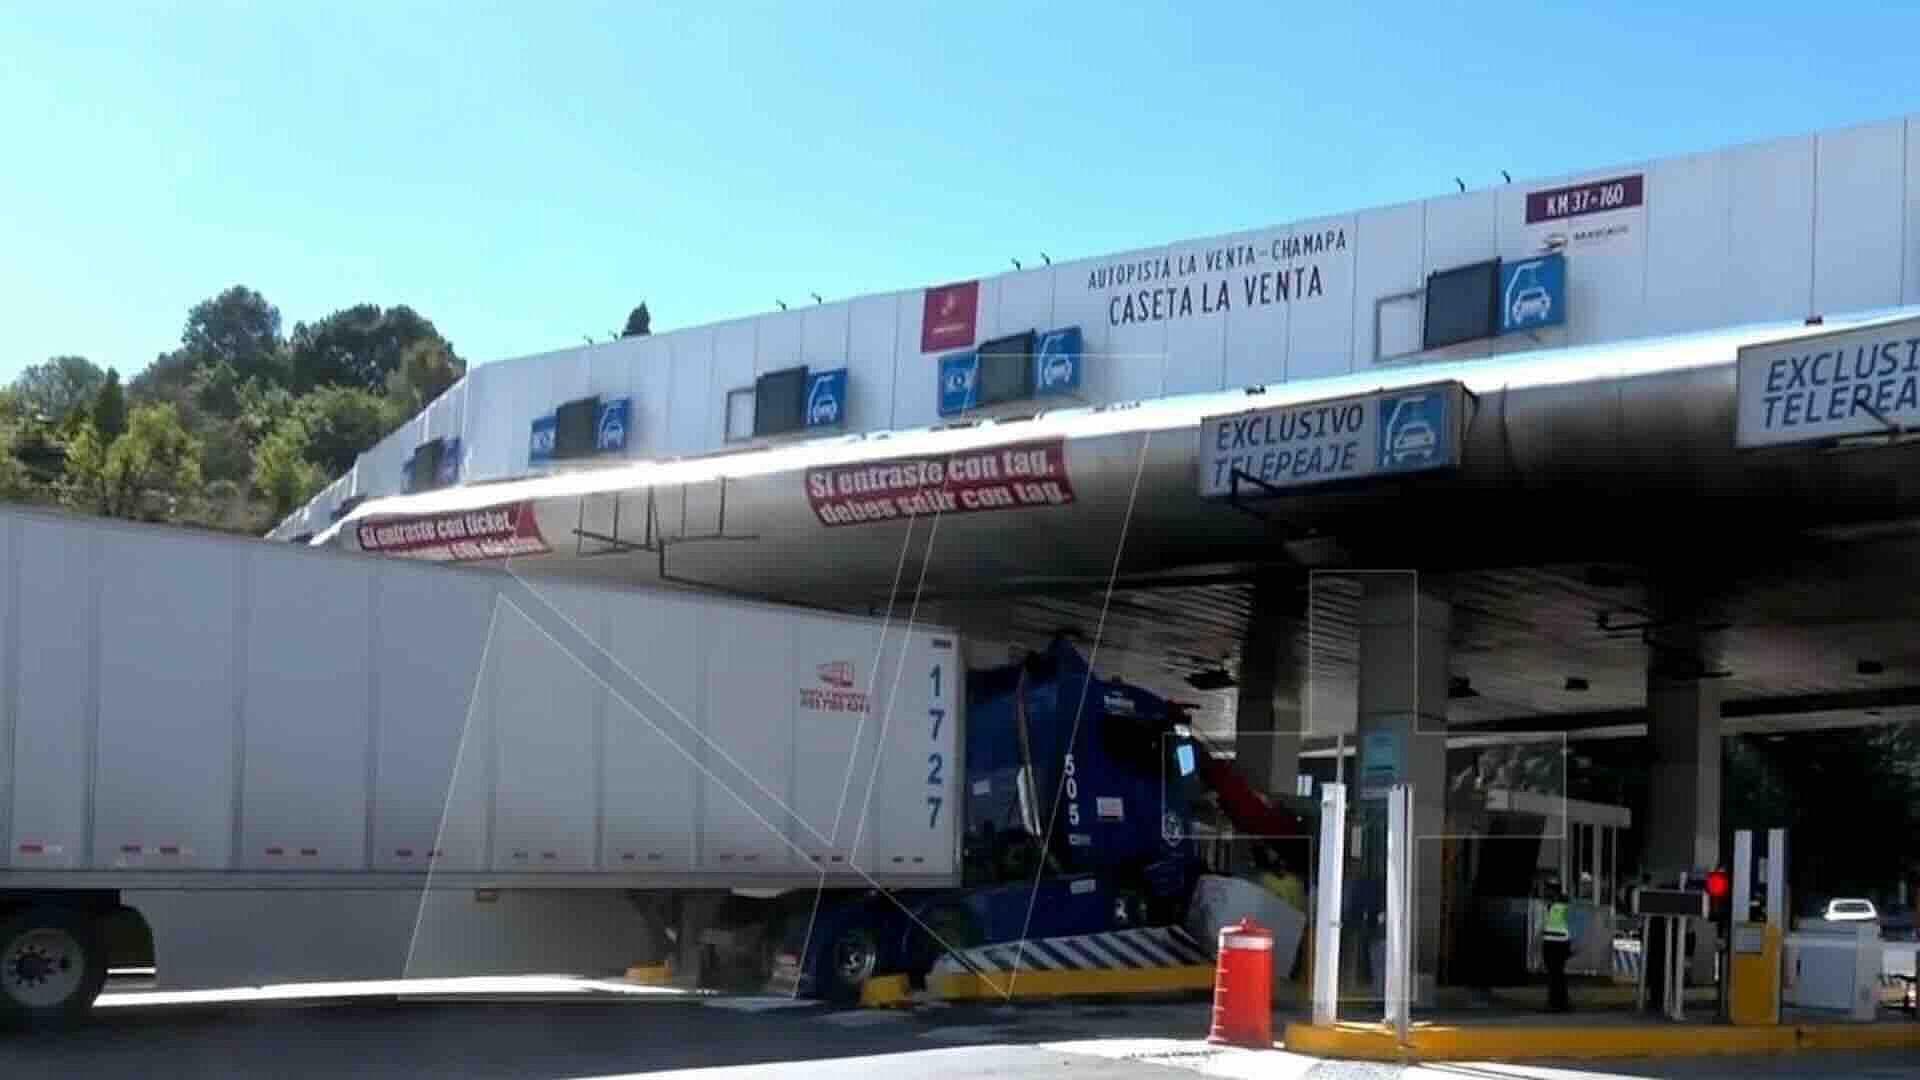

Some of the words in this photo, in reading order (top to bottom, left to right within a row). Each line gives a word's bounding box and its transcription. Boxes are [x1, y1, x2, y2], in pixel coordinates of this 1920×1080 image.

[1546, 193, 1569, 217] KM
[1087, 258, 1171, 291] AUTOPISTA
[1179, 255, 1197, 278] LA
[1109, 284, 1193, 327] CASETA
[1203, 279, 1232, 314] LA
[1244, 265, 1324, 307] VENTA
[1216, 403, 1364, 451] EXCLUSIVO
[948, 453, 998, 481] con
[1212, 441, 1360, 488] TELEPEAJE
[960, 484, 1014, 510] con
